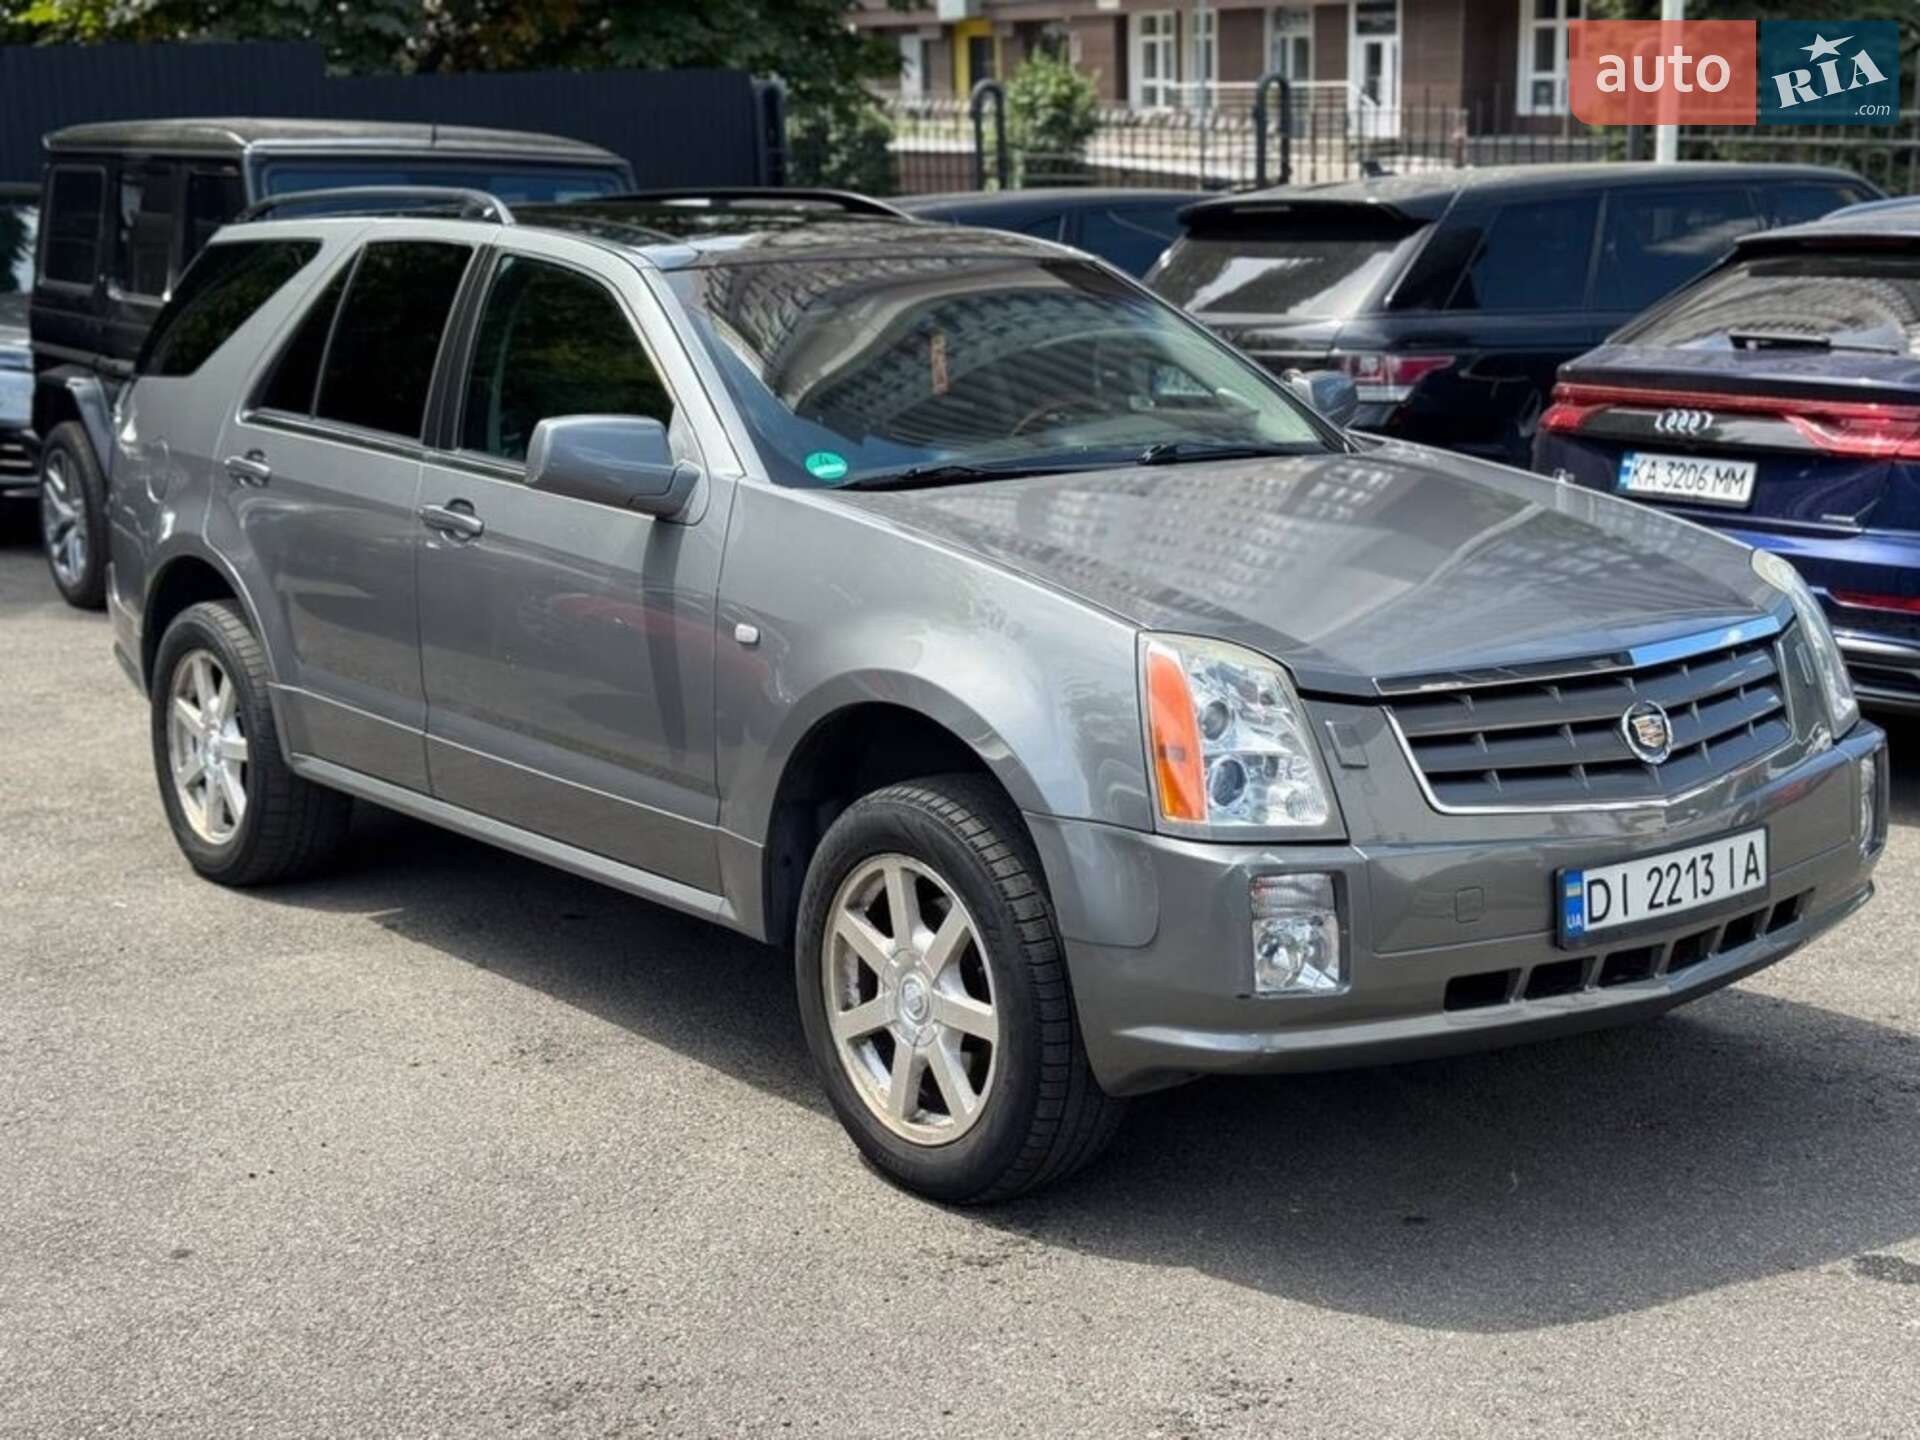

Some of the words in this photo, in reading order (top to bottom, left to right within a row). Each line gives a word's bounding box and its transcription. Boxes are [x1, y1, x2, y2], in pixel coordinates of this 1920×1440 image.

[1633, 459, 1657, 486] KA
[1662, 461, 1708, 490] 3206
[1711, 467, 1746, 495] MM
[1587, 873, 1628, 924] DI
[1647, 852, 1714, 910] 2213
[1729, 841, 1760, 889] IA
